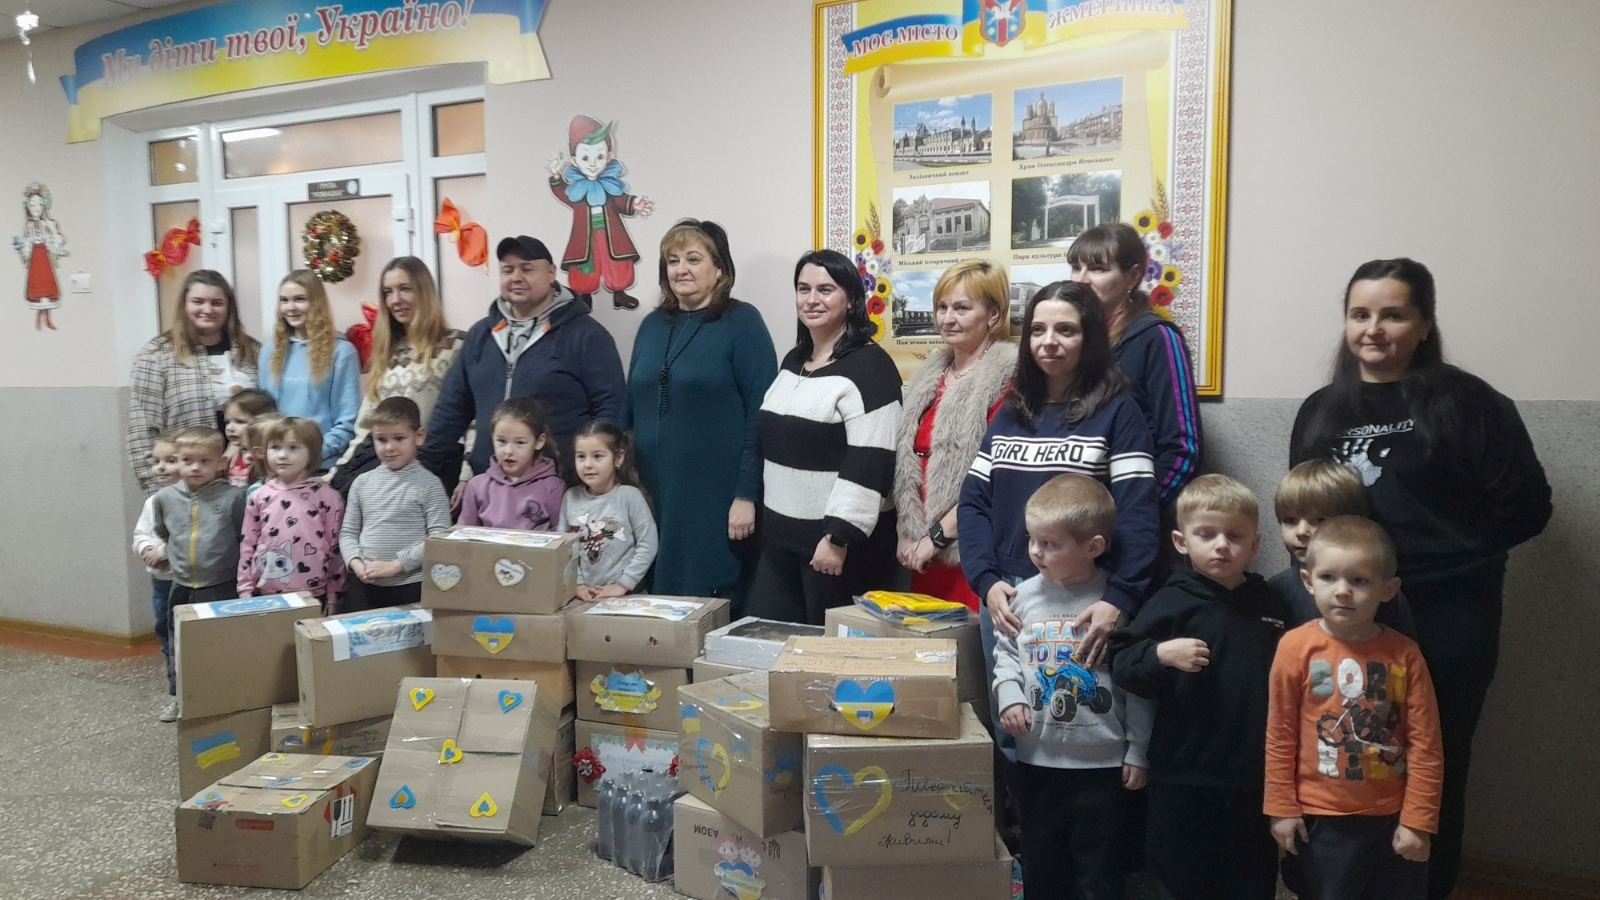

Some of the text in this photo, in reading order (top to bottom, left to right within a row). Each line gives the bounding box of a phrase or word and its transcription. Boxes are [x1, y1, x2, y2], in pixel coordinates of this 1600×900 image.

[149, 37, 219, 72] діти
[225, 14, 307, 59] твої,
[315, 0, 474, 49] Україно!
[852, 23, 960, 57] МОЄ МІСТО
[994, 443, 1085, 464] GIRL HERO
[1026, 642, 1051, 665] TO
